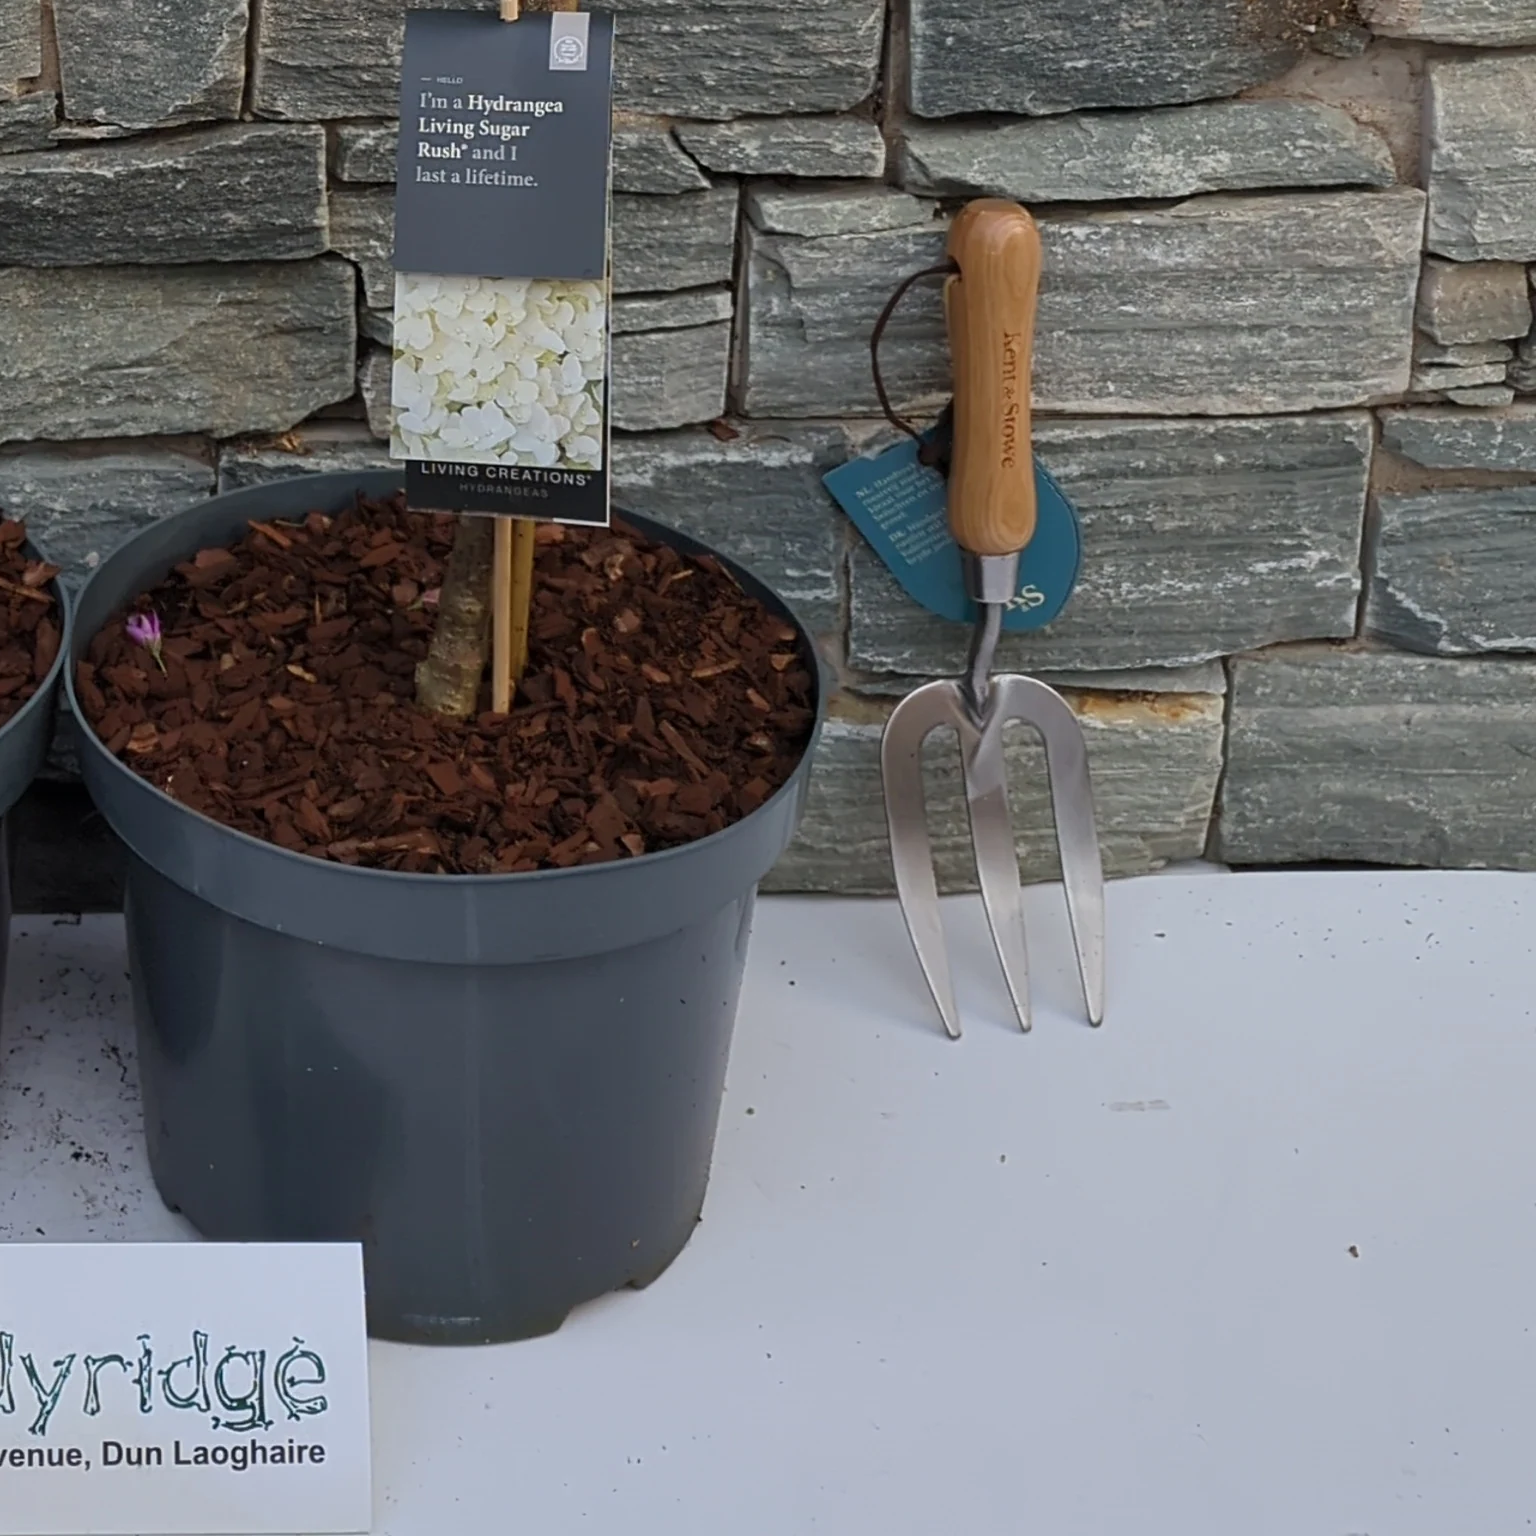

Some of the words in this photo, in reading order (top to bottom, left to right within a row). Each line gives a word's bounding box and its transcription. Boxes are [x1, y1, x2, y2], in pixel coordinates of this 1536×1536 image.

[420, 92, 447, 109] I'm
[453, 97, 463, 109] a
[467, 94, 563, 117] Hydrangea
[418, 117, 475, 139] Living
[479, 119, 531, 141] Sugar
[472, 145, 505, 161] and
[510, 146, 517, 161] I
[416, 166, 446, 183] last
[451, 172, 461, 183] a
[465, 169, 538, 187] lifetime.
[1002, 328, 1021, 381] Kent
[1001, 403, 1019, 469] Stowe
[421, 462, 479, 478] LIVING
[460, 483, 549, 499] HYDRANGEAS
[102, 1440, 163, 1467] Dun
[174, 1439, 325, 1472] Laoghaire
